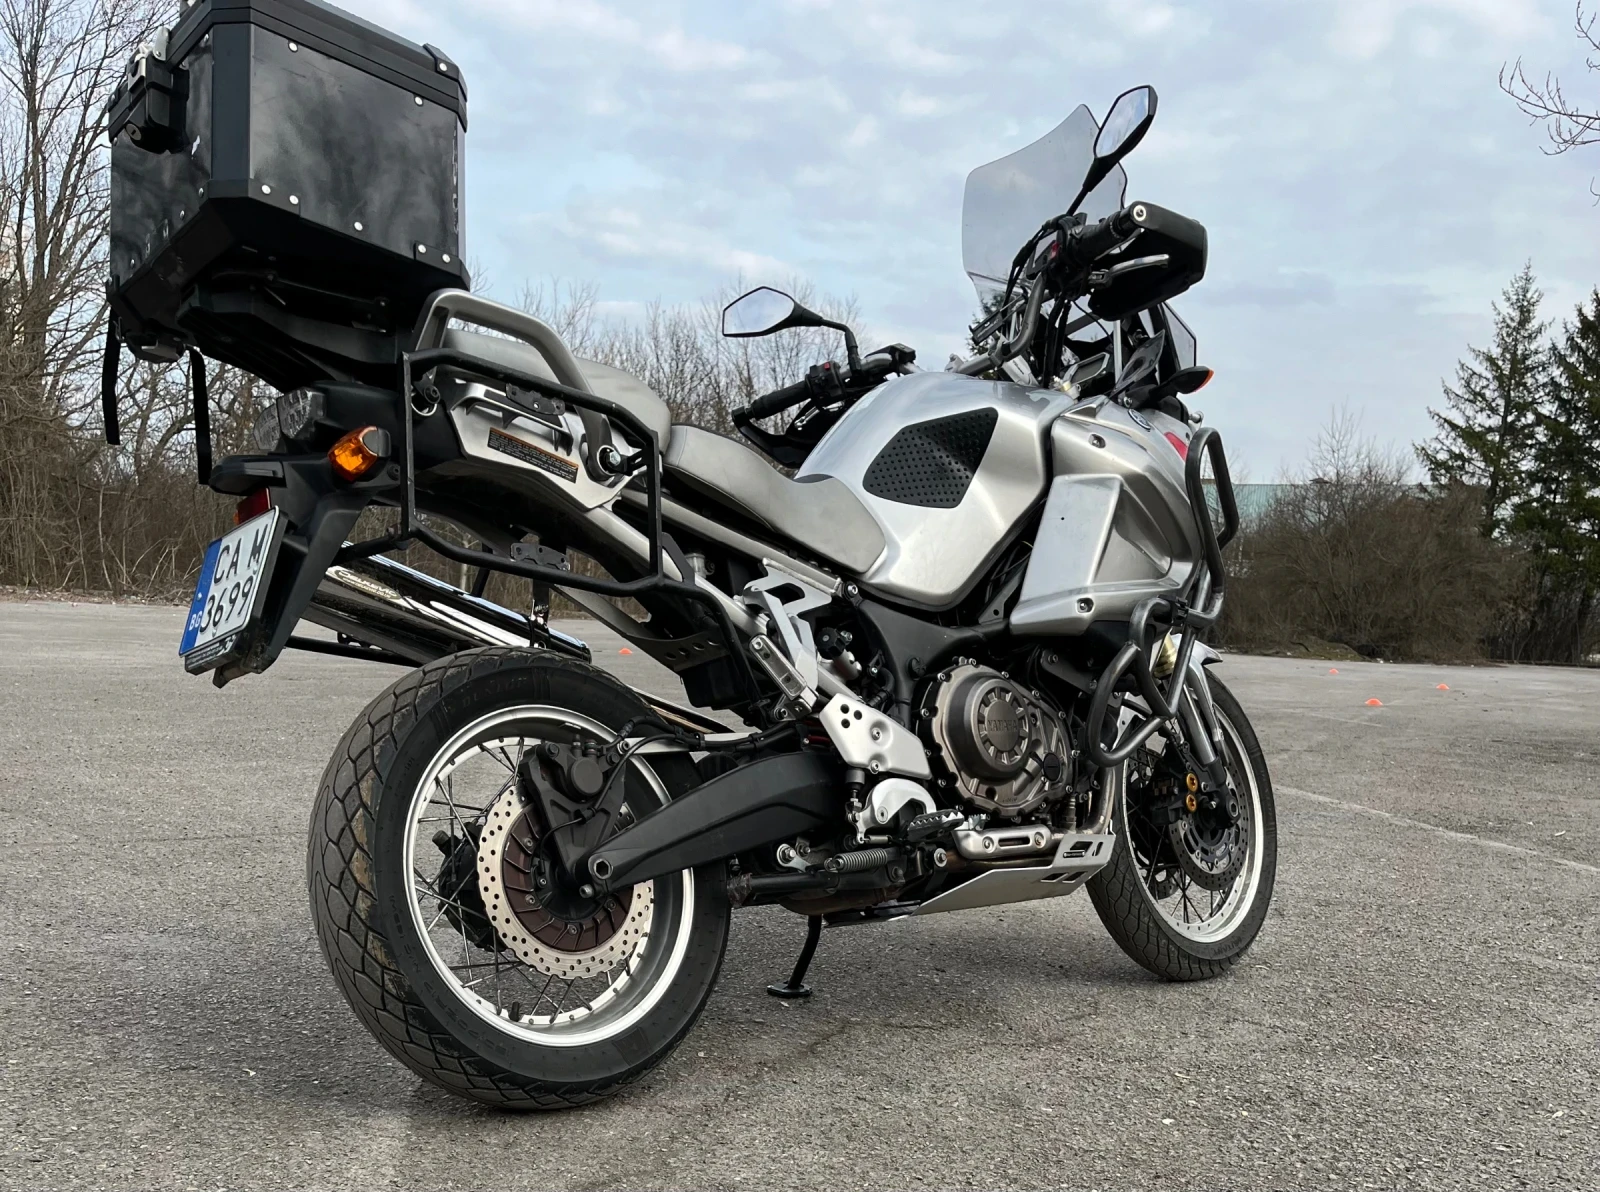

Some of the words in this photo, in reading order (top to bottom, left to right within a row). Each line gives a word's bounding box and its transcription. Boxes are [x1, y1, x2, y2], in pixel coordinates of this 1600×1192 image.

[214, 537, 242, 584] CA
[189, 610, 203, 631] BG
[200, 575, 254, 633] 3699
[987, 719, 1018, 732] YAMAHA
